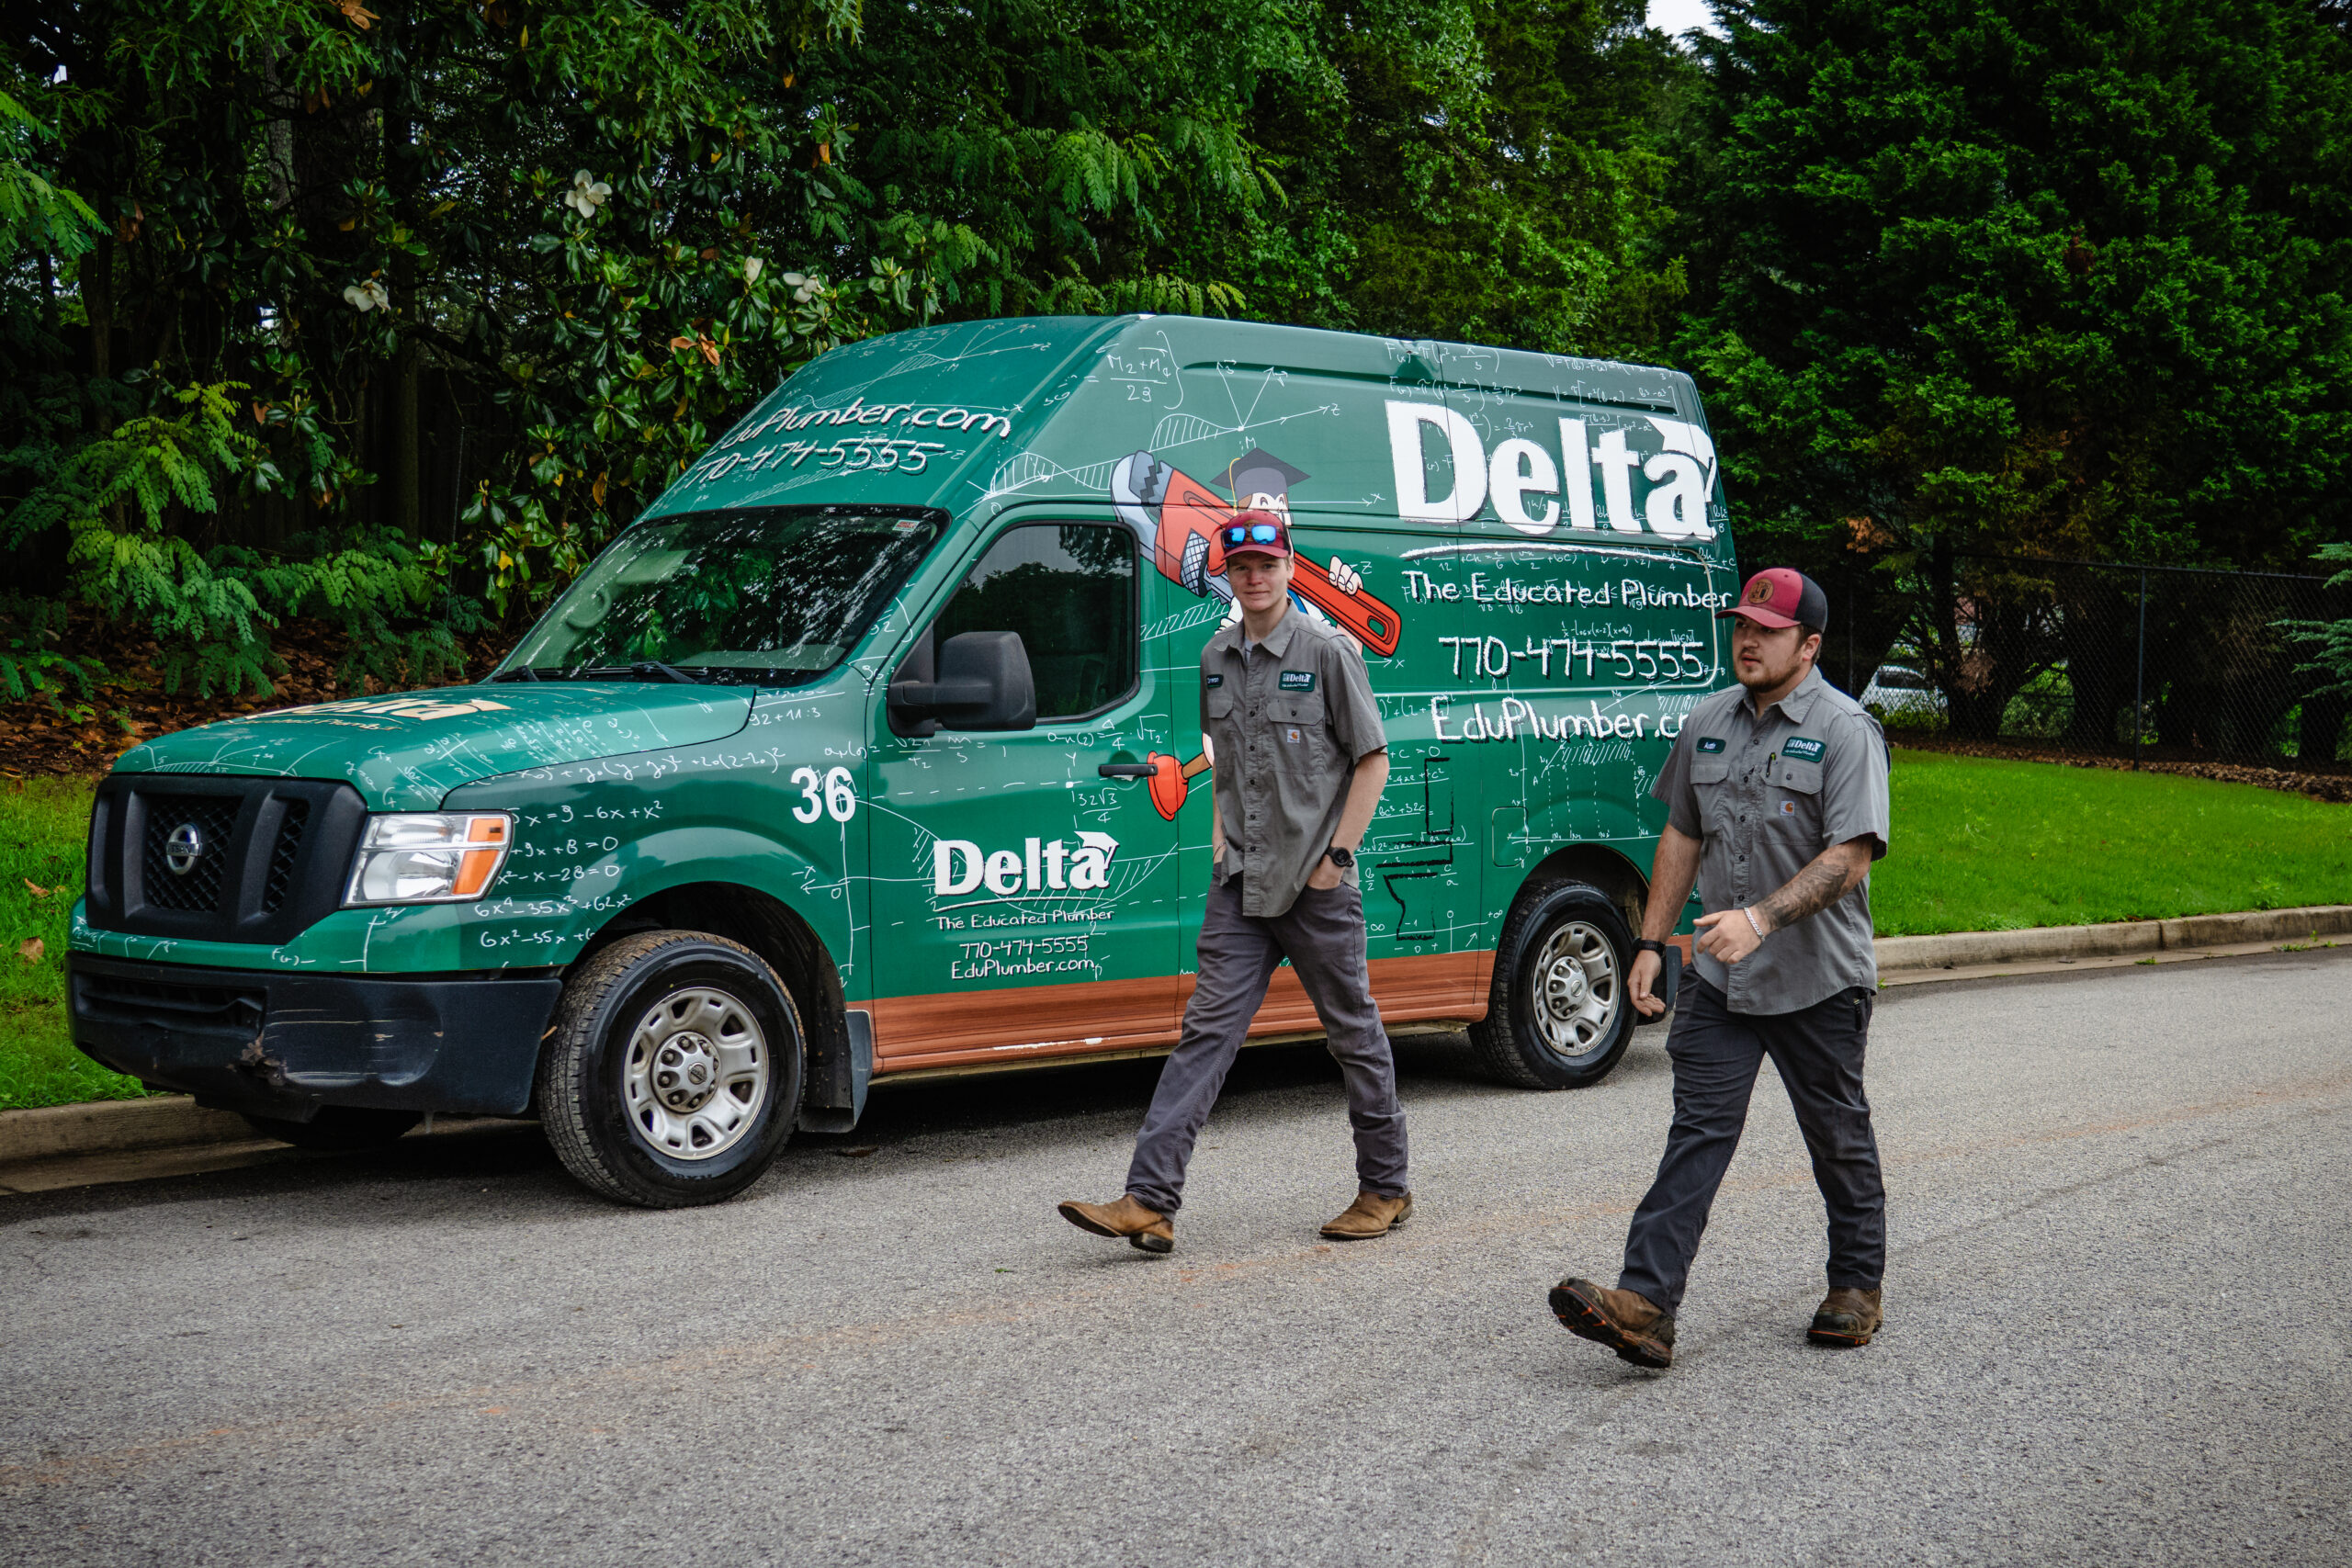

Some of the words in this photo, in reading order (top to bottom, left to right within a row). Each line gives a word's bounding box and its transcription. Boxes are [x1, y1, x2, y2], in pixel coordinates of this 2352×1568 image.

[1385, 400, 1717, 541] Delta
[1401, 570, 1463, 601] The
[1471, 573, 1610, 604] Educated
[1622, 579, 1732, 608] Plumber
[1439, 636, 1702, 677] 770-474-5555
[1289, 674, 1311, 682] Delta
[1794, 739, 1821, 751] Delta
[791, 766, 856, 824] 36
[933, 830, 1119, 896] Delta
[935, 917, 965, 930] The
[971, 913, 1046, 928] Educated
[1053, 908, 1114, 922] Plumber
[959, 935, 1090, 959] 770-474-5555
[952, 958, 1095, 980] EduPlumber.com
